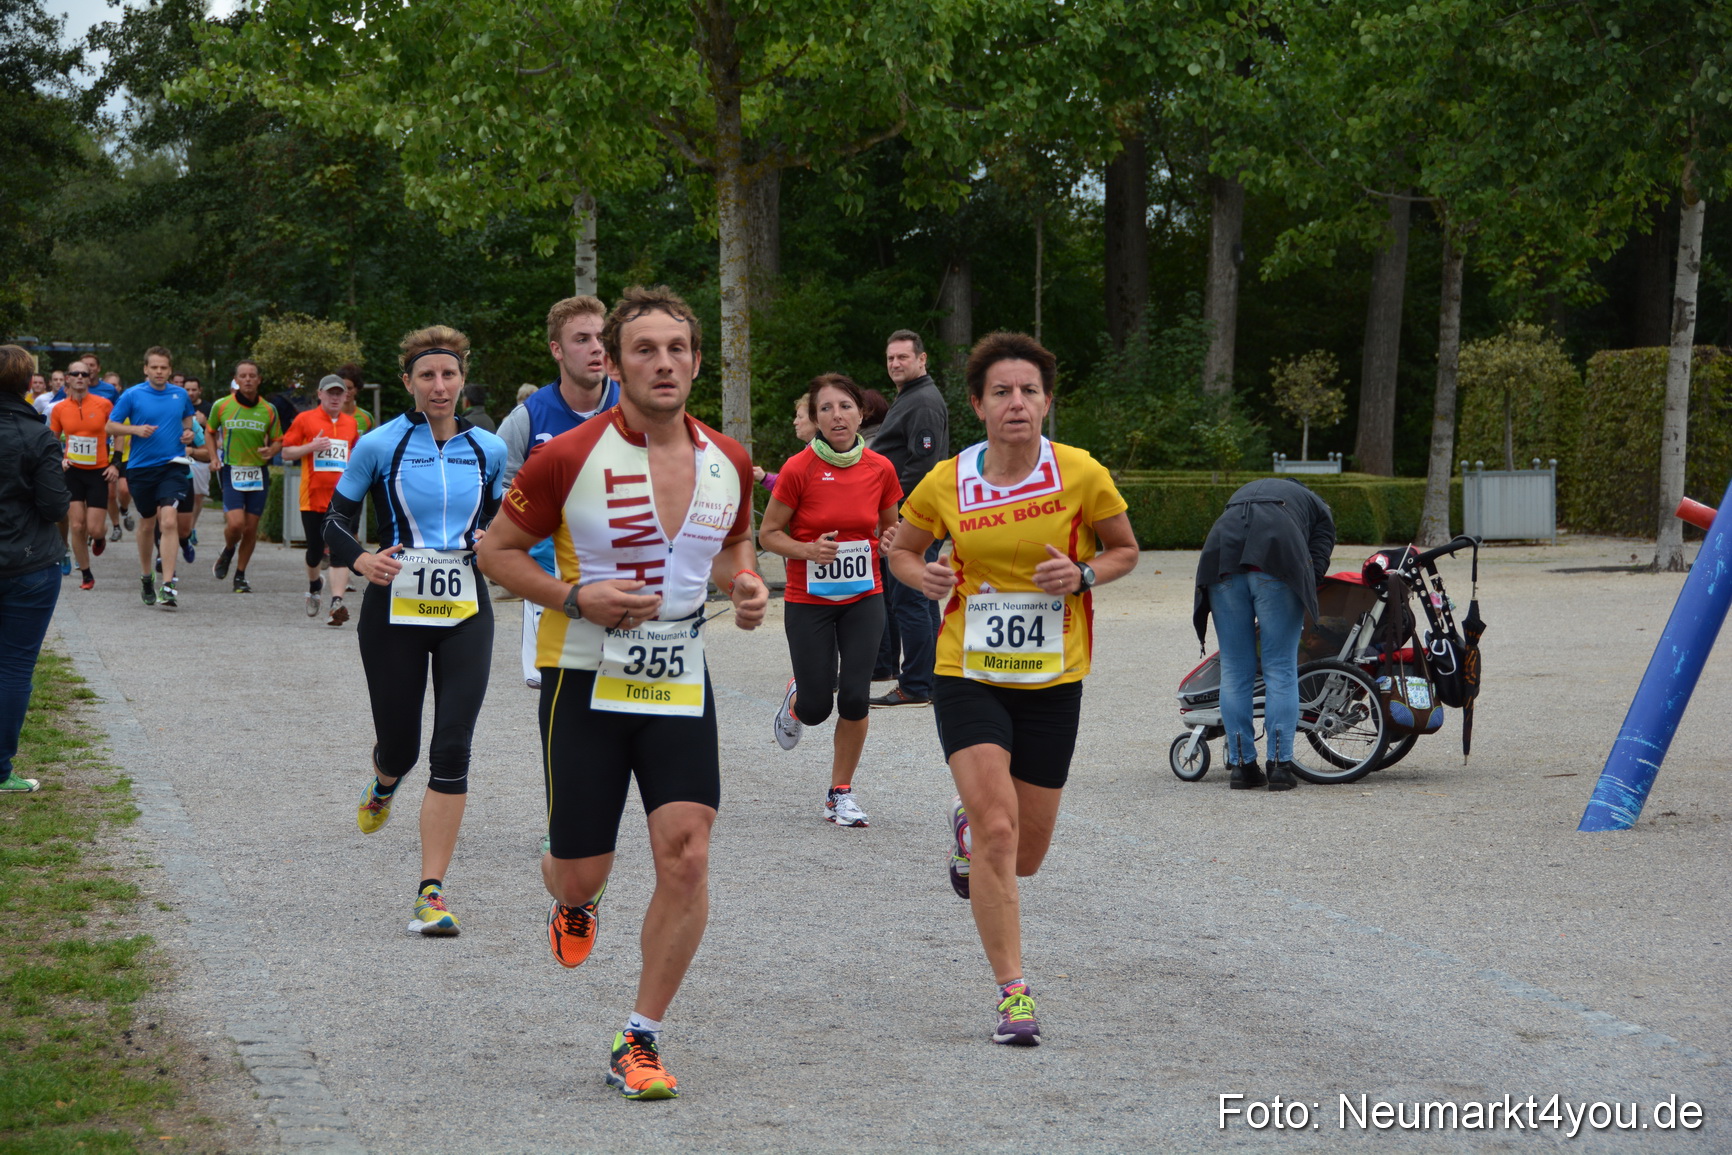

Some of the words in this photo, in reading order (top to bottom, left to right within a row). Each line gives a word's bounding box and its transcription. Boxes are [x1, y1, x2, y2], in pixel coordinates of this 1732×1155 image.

[225, 419, 266, 432] BOCK
[73, 442, 90, 454] 511
[317, 447, 346, 459] 2424
[234, 470, 260, 481] 2792
[693, 501, 722, 510] FITNESS
[959, 512, 1007, 533] MAX
[1013, 499, 1067, 522] BÖGL
[835, 547, 862, 555] eumarkt
[427, 557, 461, 565] Neumarkt
[814, 555, 867, 580] 3060
[413, 567, 462, 597] 166
[418, 603, 453, 617] Sandy
[968, 603, 1000, 612] PARTL
[1002, 602, 1048, 611] Neumarkt
[607, 628, 644, 640] PARTL
[647, 630, 687, 640] Neumarkt
[985, 615, 1045, 648] 364
[623, 645, 684, 679] 355
[984, 655, 1043, 670] Marianne
[626, 684, 671, 701] Tobias
